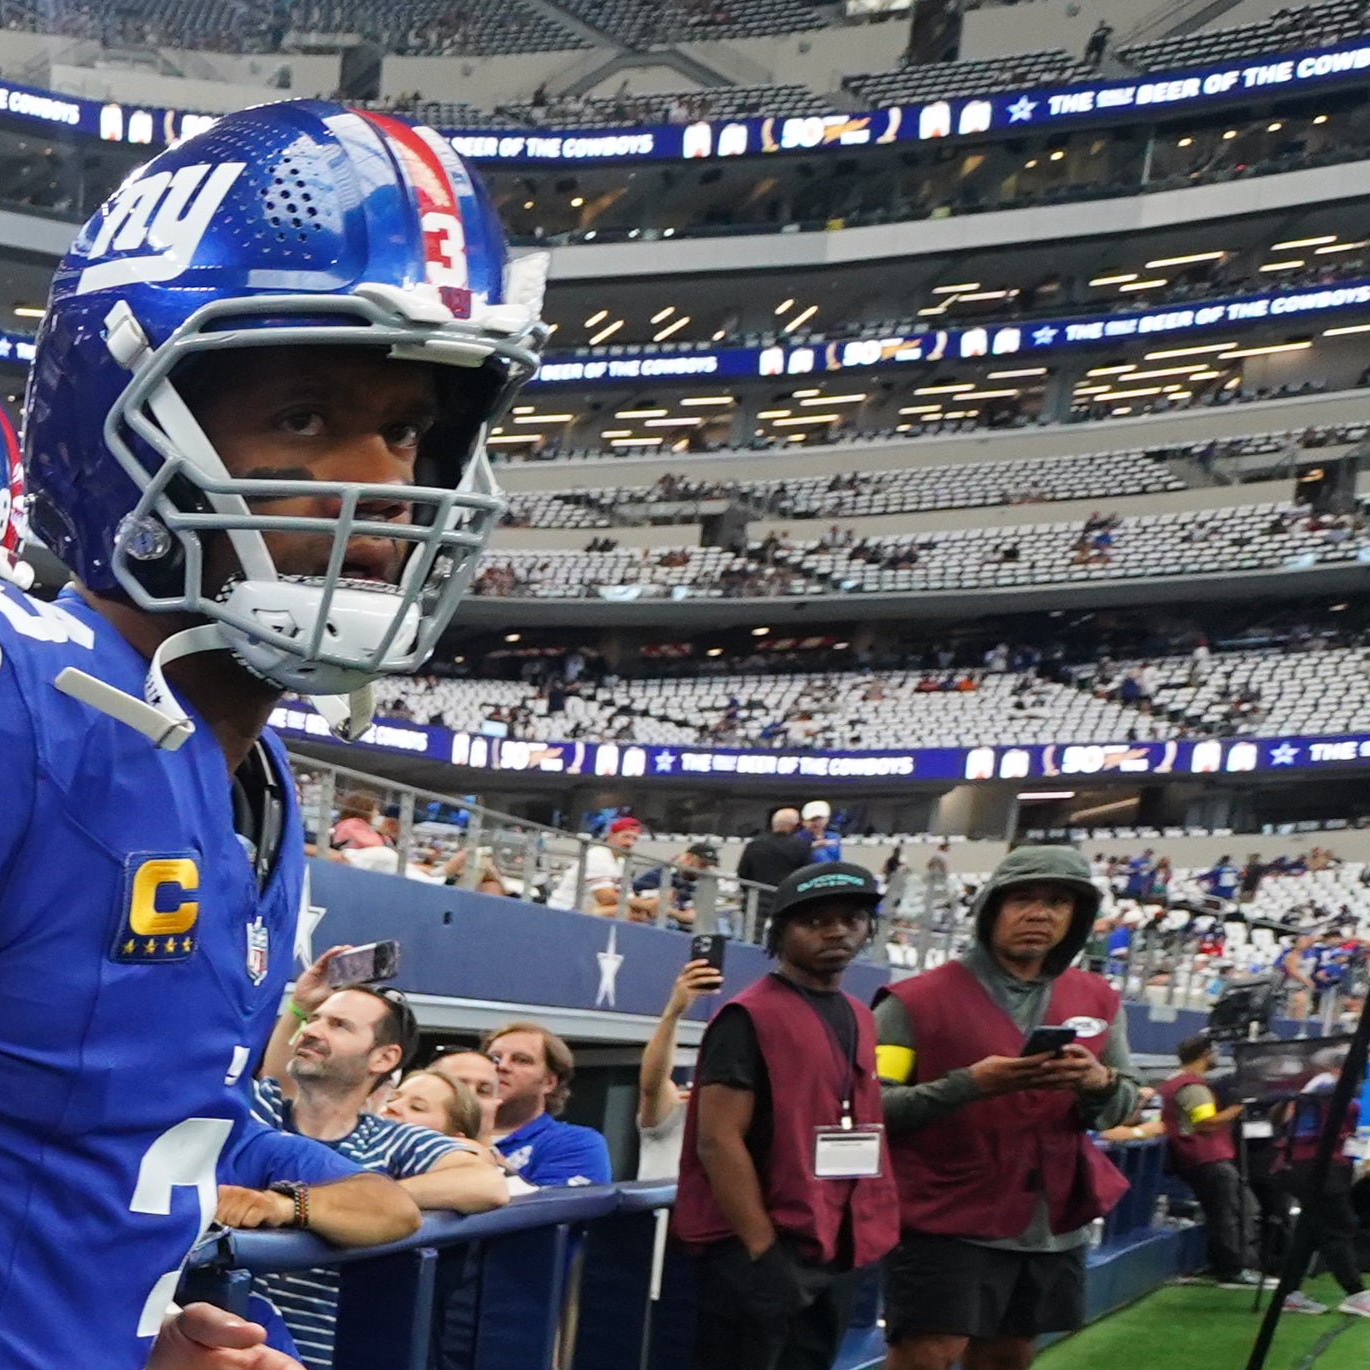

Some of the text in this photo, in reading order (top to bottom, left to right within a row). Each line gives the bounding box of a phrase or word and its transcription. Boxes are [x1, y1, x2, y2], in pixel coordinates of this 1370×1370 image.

[1048, 91, 1095, 115] THE
[1136, 78, 1201, 105] BEER
[1204, 71, 1240, 94] OF
[1243, 62, 1294, 87] THE
[421, 212, 468, 291] 3
[129, 858, 200, 936] C
